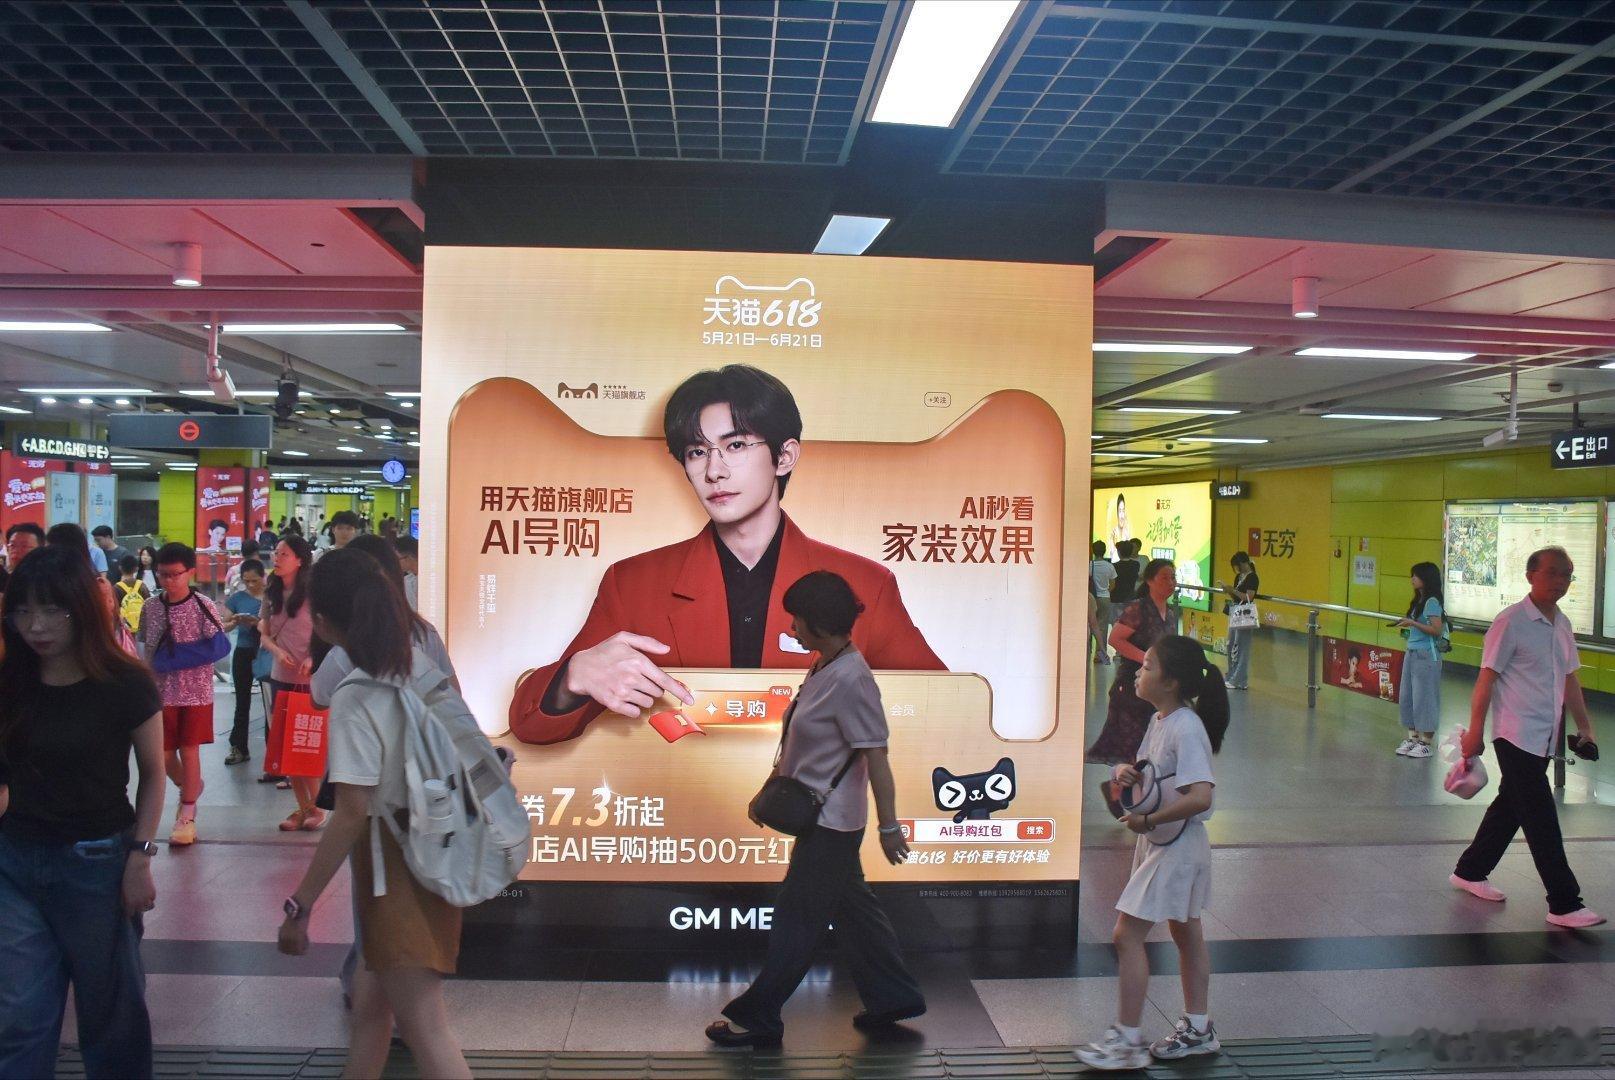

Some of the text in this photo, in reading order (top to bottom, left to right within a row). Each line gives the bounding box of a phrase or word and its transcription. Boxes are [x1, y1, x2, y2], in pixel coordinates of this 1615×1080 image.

[702, 298, 823, 328] 天猫618
[602, 389, 646, 400] 天猫旗舰店
[1571, 436, 1608, 460] E 出口
[480, 486, 634, 514] 用天猫旗舰店
[959, 495, 1035, 521] AI秒看
[480, 517, 600, 557] AI导购
[882, 523, 1035, 565] 家装效果
[1262, 529, 1296, 559] 无穷
[725, 699, 766, 718] 导购
[890, 704, 915, 717] 会员
[521, 787, 665, 827] 券7.3折起
[939, 824, 1002, 838] AI导购红包
[1026, 826, 1044, 835] 搜索
[527, 836, 795, 865] 店AI导购抽500元红
[899, 849, 1050, 865] 猫618 好价更有好体验
[669, 907, 775, 930] GM ME
